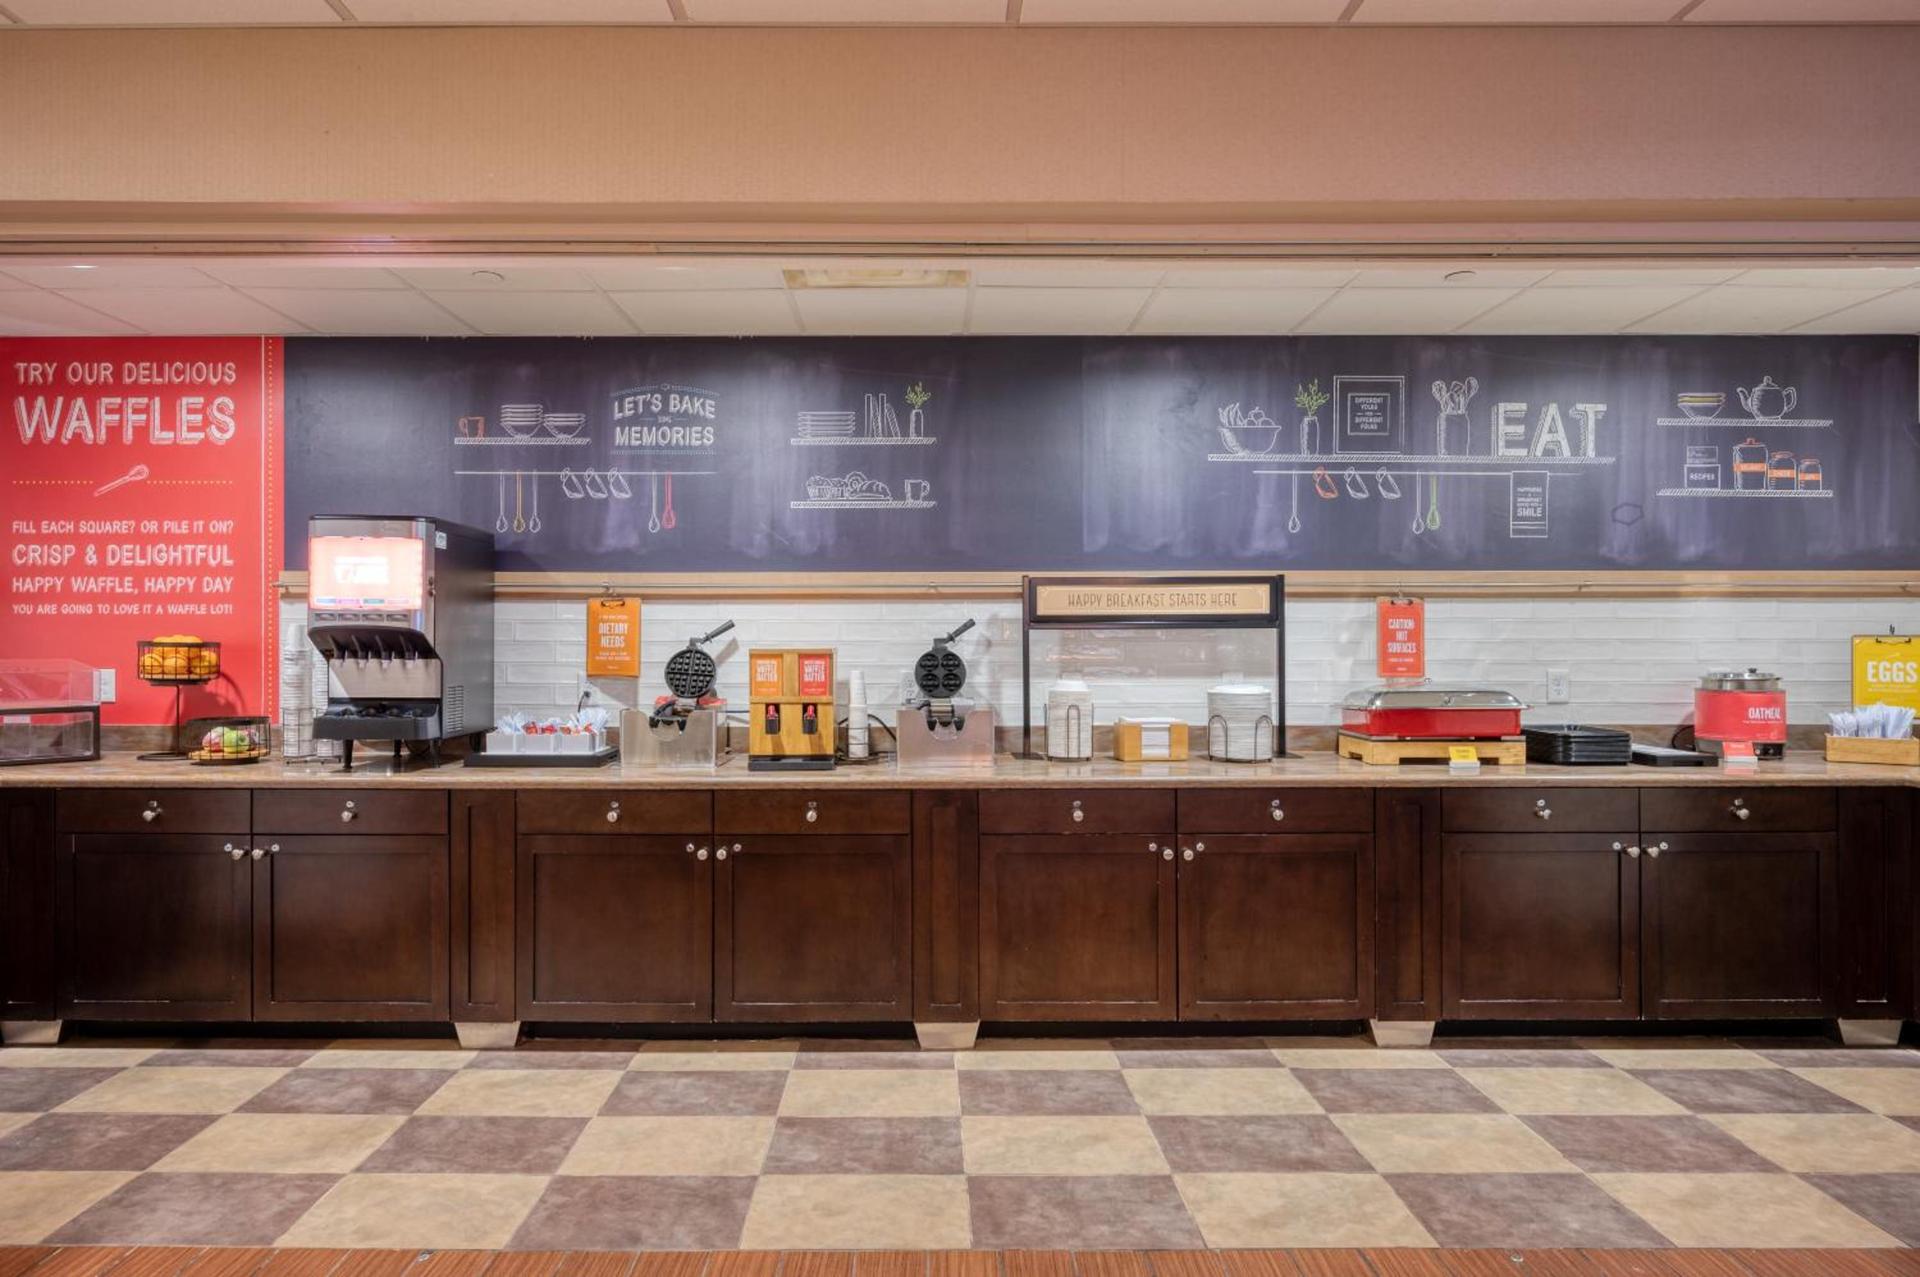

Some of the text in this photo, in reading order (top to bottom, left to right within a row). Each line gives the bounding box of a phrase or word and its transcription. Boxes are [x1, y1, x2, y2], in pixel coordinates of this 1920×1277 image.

[15, 362, 237, 385] TRY OUR DELICIOUS
[613, 393, 716, 420] LET'S BAKE
[14, 396, 236, 445] WAFFLES
[614, 426, 715, 446] MEMORIES
[1491, 402, 1607, 458] EAT
[1517, 507, 1542, 517] SMILE
[12, 520, 234, 534] FILL EACH SQUARE? OR PILE IT ON?
[12, 543, 234, 567] CRISP & DELIGHTFUL
[12, 577, 234, 595] HAPPY WAFFLE, HAPPY DAY
[1068, 592, 1238, 607] HAPPY BREAKFAST STARTS HERE
[12, 604, 233, 615] YOU ARE GOING TO LOVE IT A WAFFLE LOT!
[599, 622, 628, 635] DIETARY
[1396, 630, 1408, 641] HOT
[601, 636, 625, 648] NEEDS
[1867, 661, 1918, 683] EGGS
